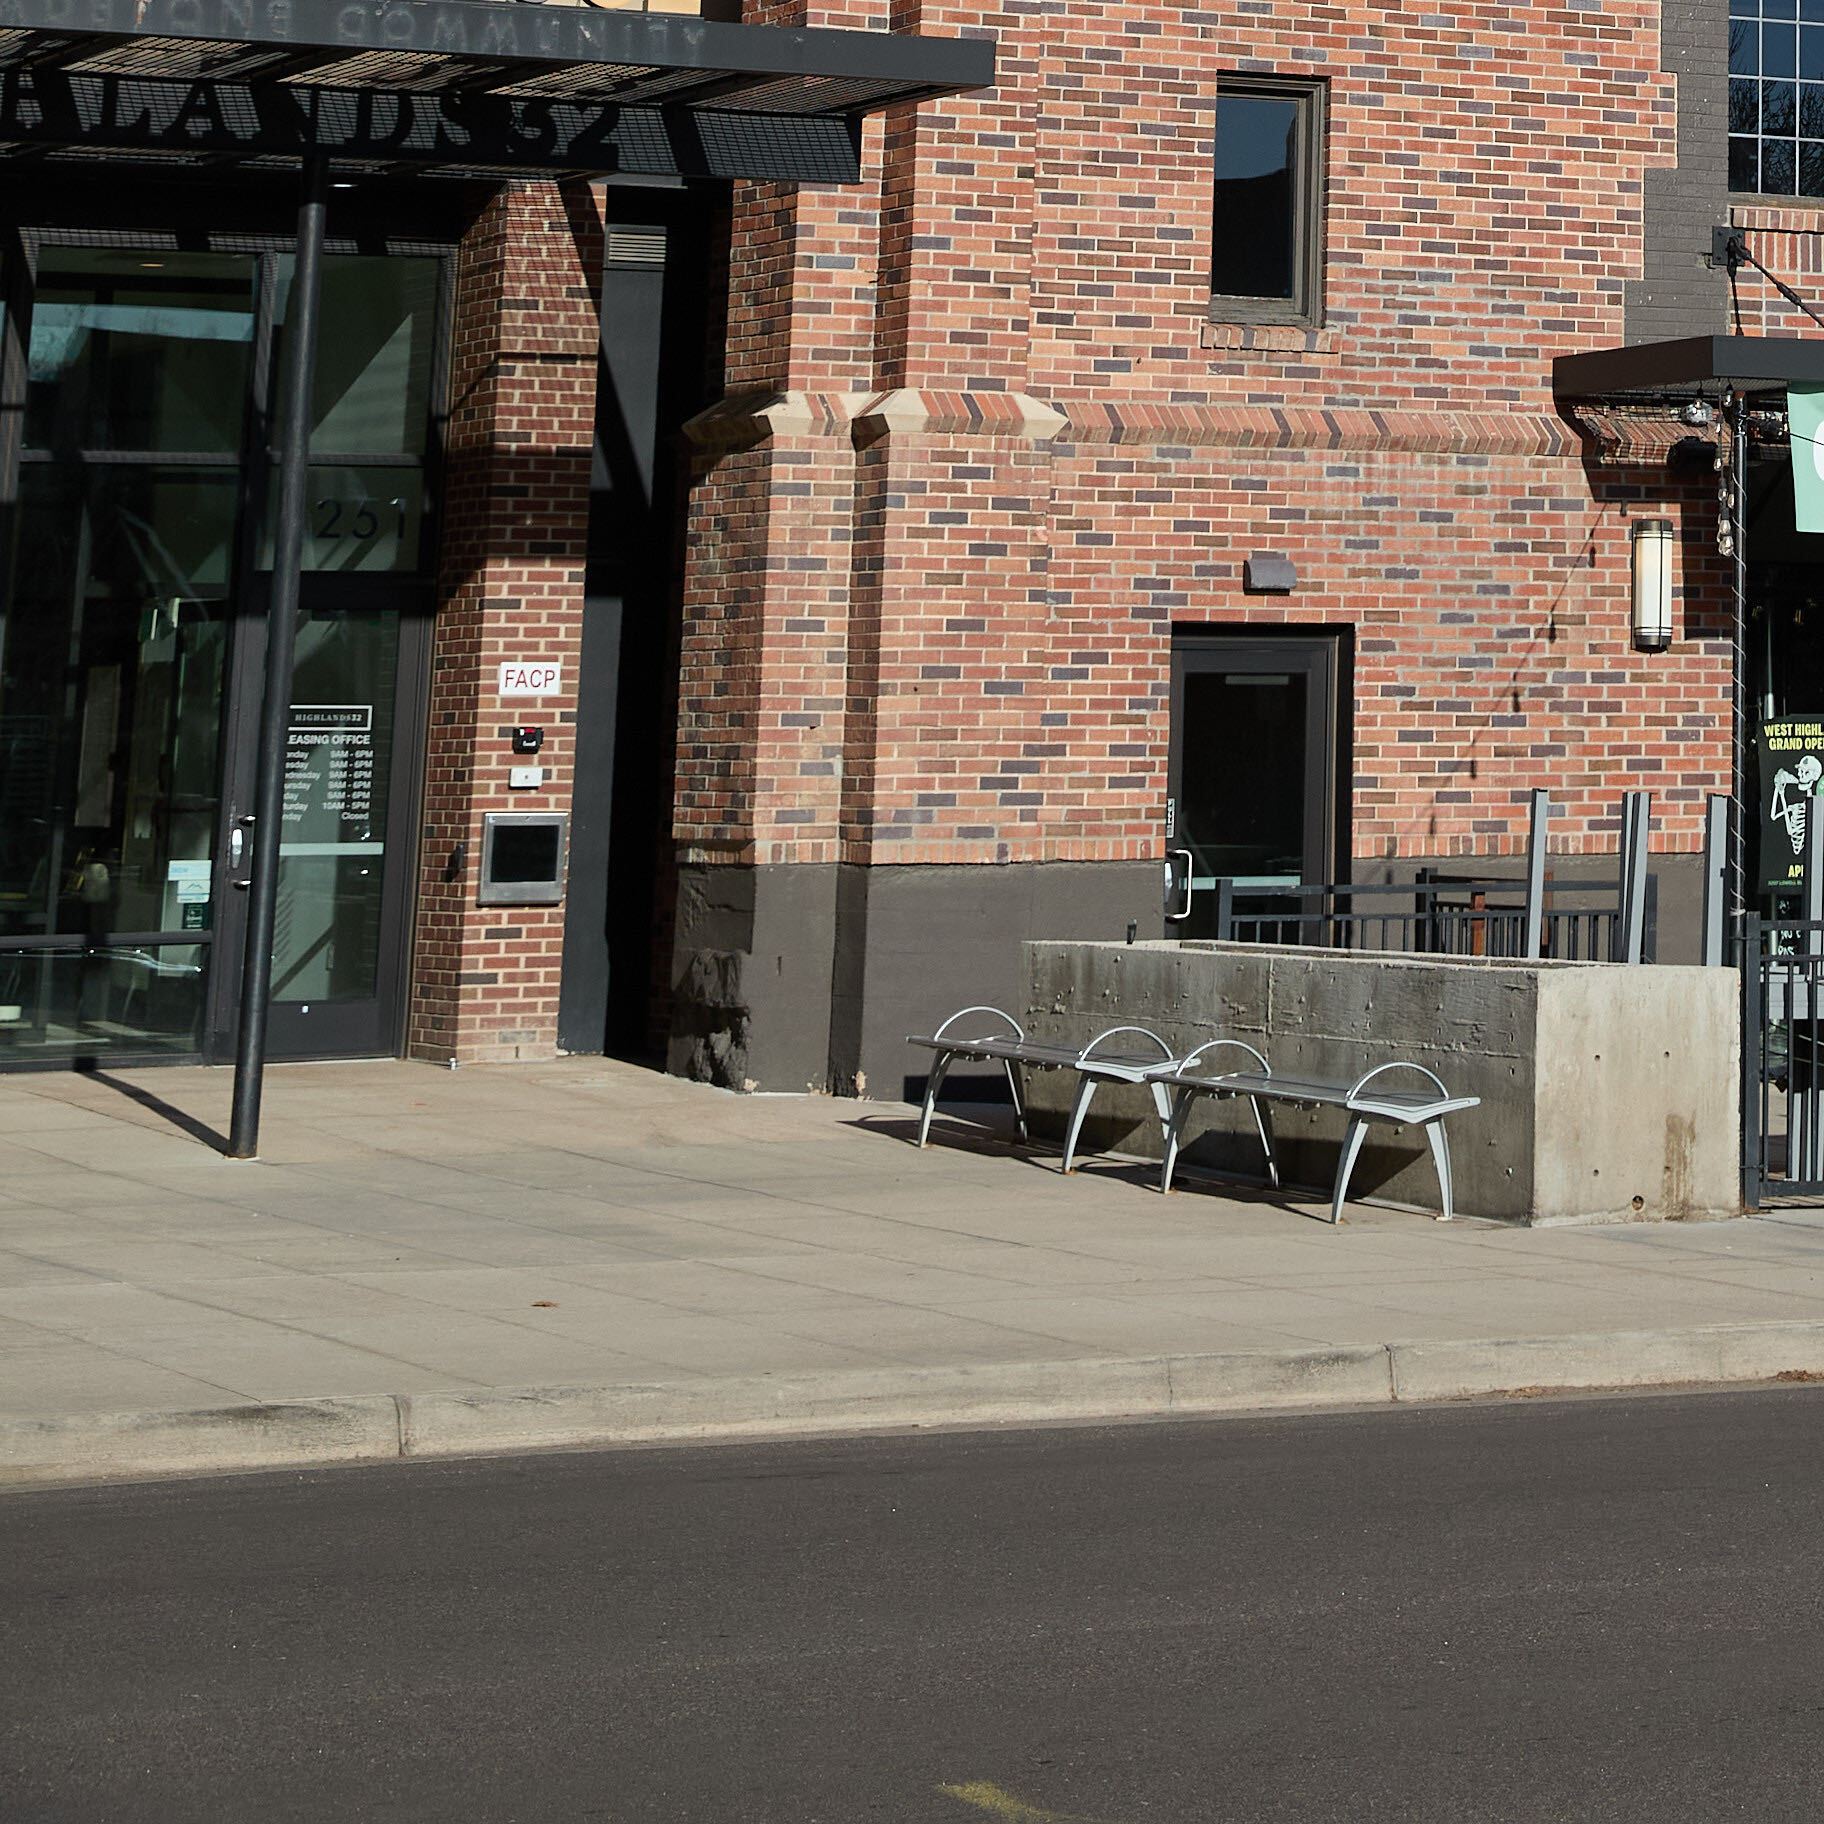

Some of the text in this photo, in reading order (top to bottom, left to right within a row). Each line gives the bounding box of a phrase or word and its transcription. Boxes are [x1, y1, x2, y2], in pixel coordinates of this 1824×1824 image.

[504, 669, 556, 688] FACP
[1764, 723, 1793, 737] WEST
[287, 734, 371, 745] EASING OFFICE
[1768, 738, 1803, 751] GRAND
[341, 812, 370, 820] Closed
